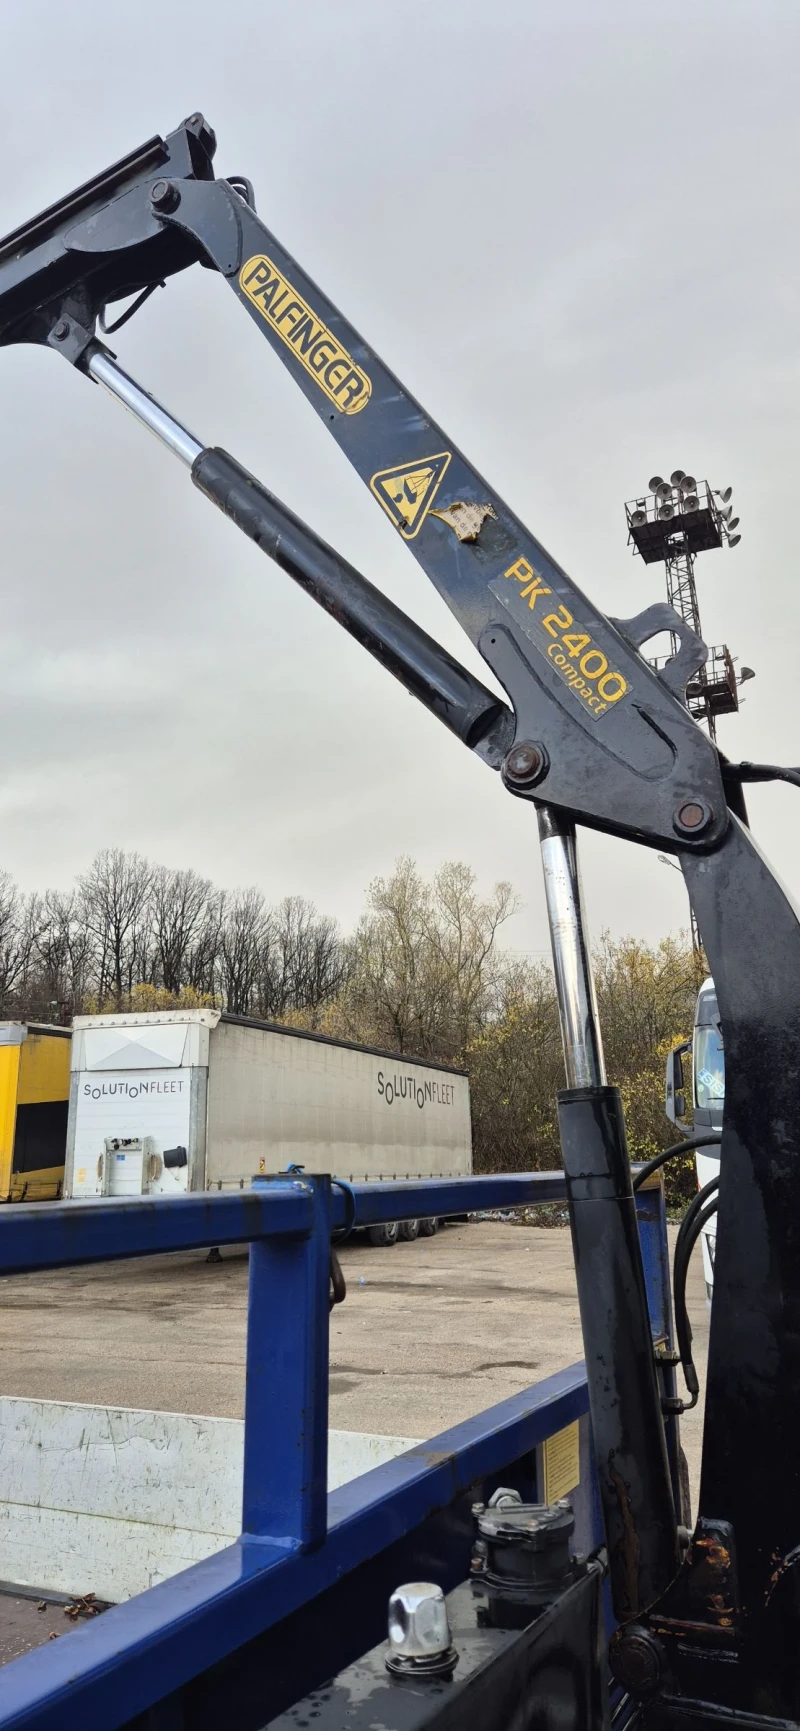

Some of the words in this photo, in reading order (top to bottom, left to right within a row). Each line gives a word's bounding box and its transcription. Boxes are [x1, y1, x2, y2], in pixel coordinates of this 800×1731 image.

[244, 261, 364, 409] PALFINGER
[504, 556, 552, 610] PK
[542, 605, 627, 702] 2400
[547, 643, 607, 714] Compact
[83, 1080, 185, 1099] SOLUTIONFLEET
[377, 1071, 455, 1109] SOLUTIONFLEET
